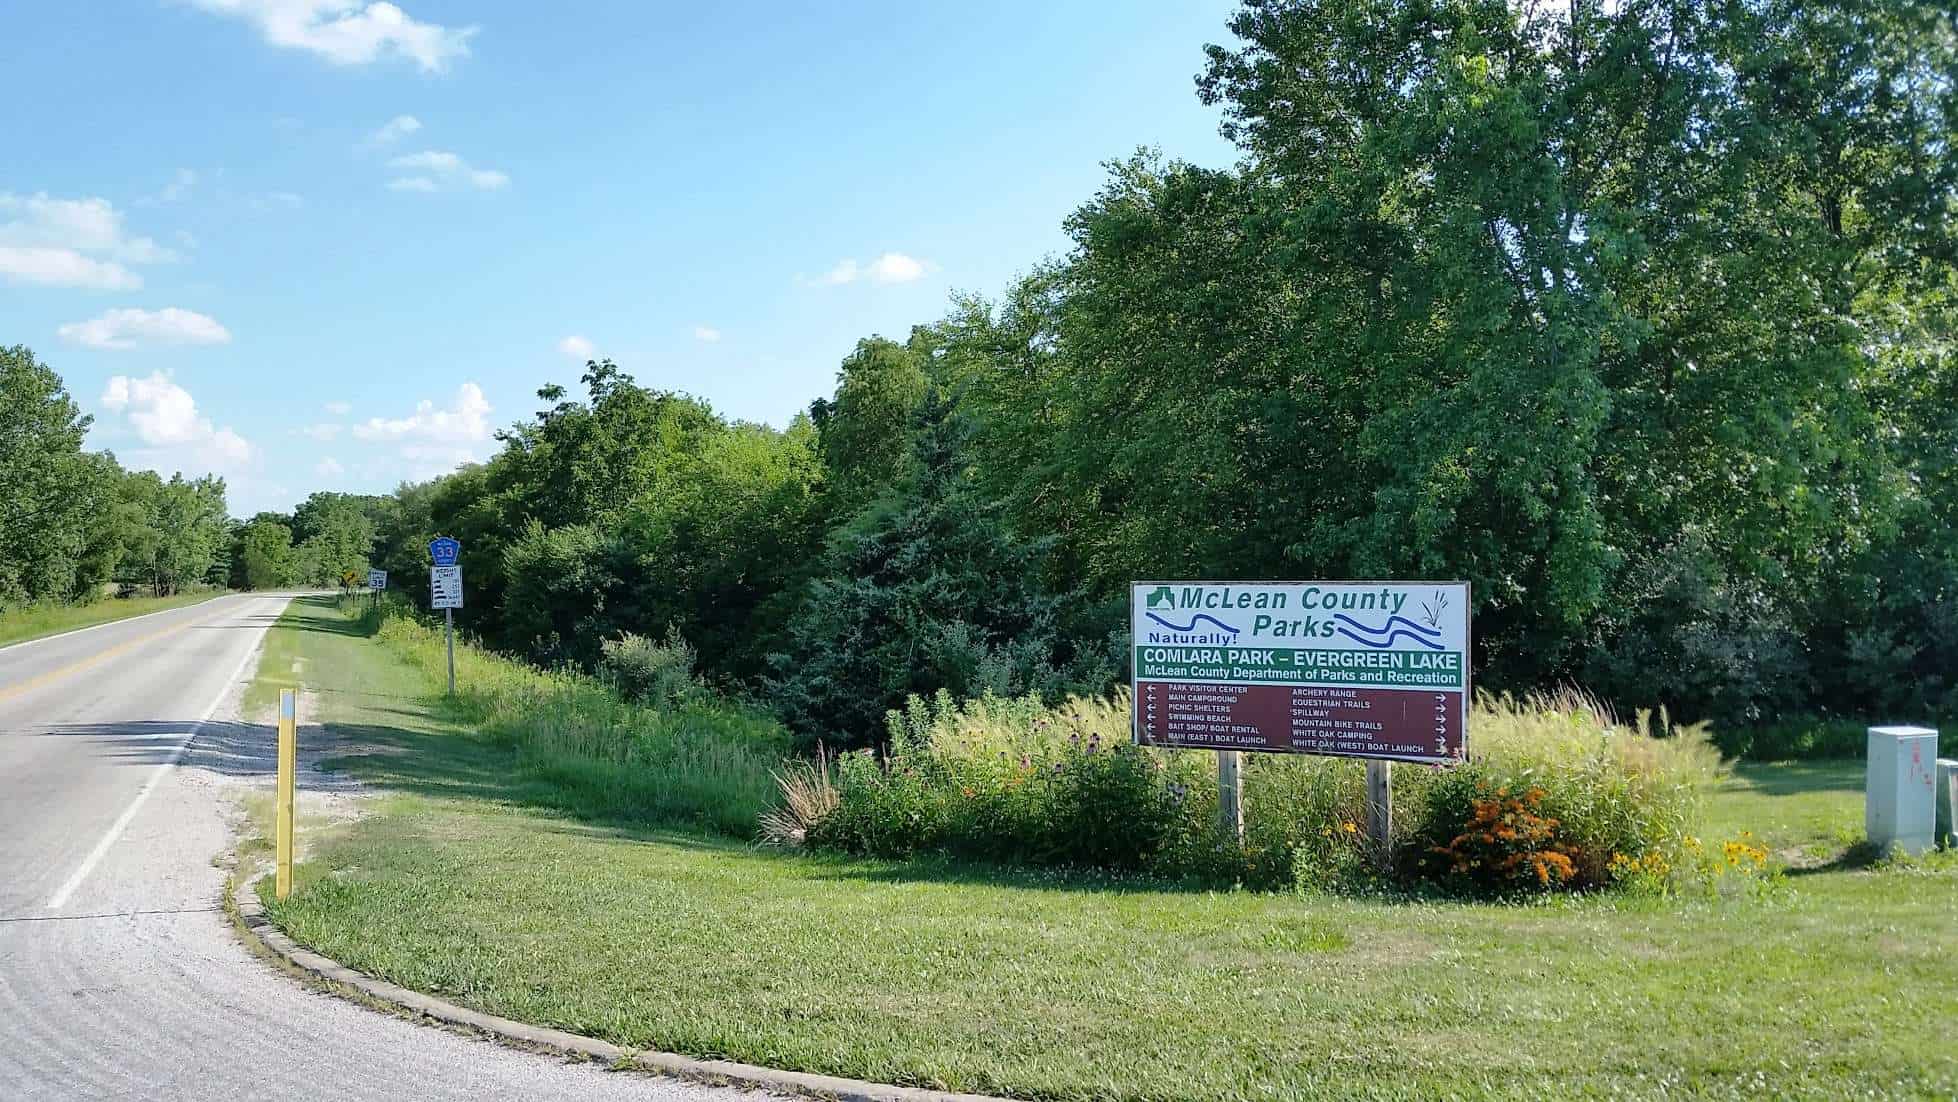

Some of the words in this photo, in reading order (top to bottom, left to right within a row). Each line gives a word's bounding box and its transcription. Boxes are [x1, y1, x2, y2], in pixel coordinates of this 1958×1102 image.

[437, 547, 453, 557] 33
[1180, 588, 1287, 608] McLean
[1302, 587, 1407, 615] County
[1253, 614, 1335, 638] Parks
[1149, 633, 1237, 646] Naturally!
[1144, 649, 1223, 664] COMLARA
[1228, 651, 1274, 665] PARK
[1294, 651, 1403, 668] EVERGREEN
[1409, 654, 1457, 669] LAKE
[1145, 665, 1187, 676] McLean
[1191, 666, 1230, 679] County
[1233, 667, 1301, 680] Department
[1305, 670, 1317, 679] of
[1321, 670, 1356, 680] Parks
[1360, 671, 1383, 681] and
[1387, 672, 1457, 684] Recreation
[1188, 695, 1238, 703] CAMPGROUND
[1292, 699, 1341, 707] EQUESTRIAN
[1194, 705, 1231, 713] SHELTERS
[1292, 709, 1329, 717] SPILLWAY
[1168, 713, 1204, 721] SWIMMING
[1292, 719, 1332, 727] MOUNTAIN
[1355, 722, 1382, 730] TRAILS
[1232, 726, 1260, 734] RENTAL
[1292, 729, 1316, 737] WHITE
[1319, 730, 1335, 738] OAK
[1337, 732, 1372, 740] CAMPING
[1216, 735, 1235, 743] BOAT
[1237, 737, 1266, 745] LAUNCH
[1292, 739, 1316, 747] WHITE
[1319, 740, 1335, 748] OAK
[1337, 742, 1365, 751] (WEST)
[1368, 743, 1388, 751] BOAT
[1391, 744, 1424, 753] LAUNCH
